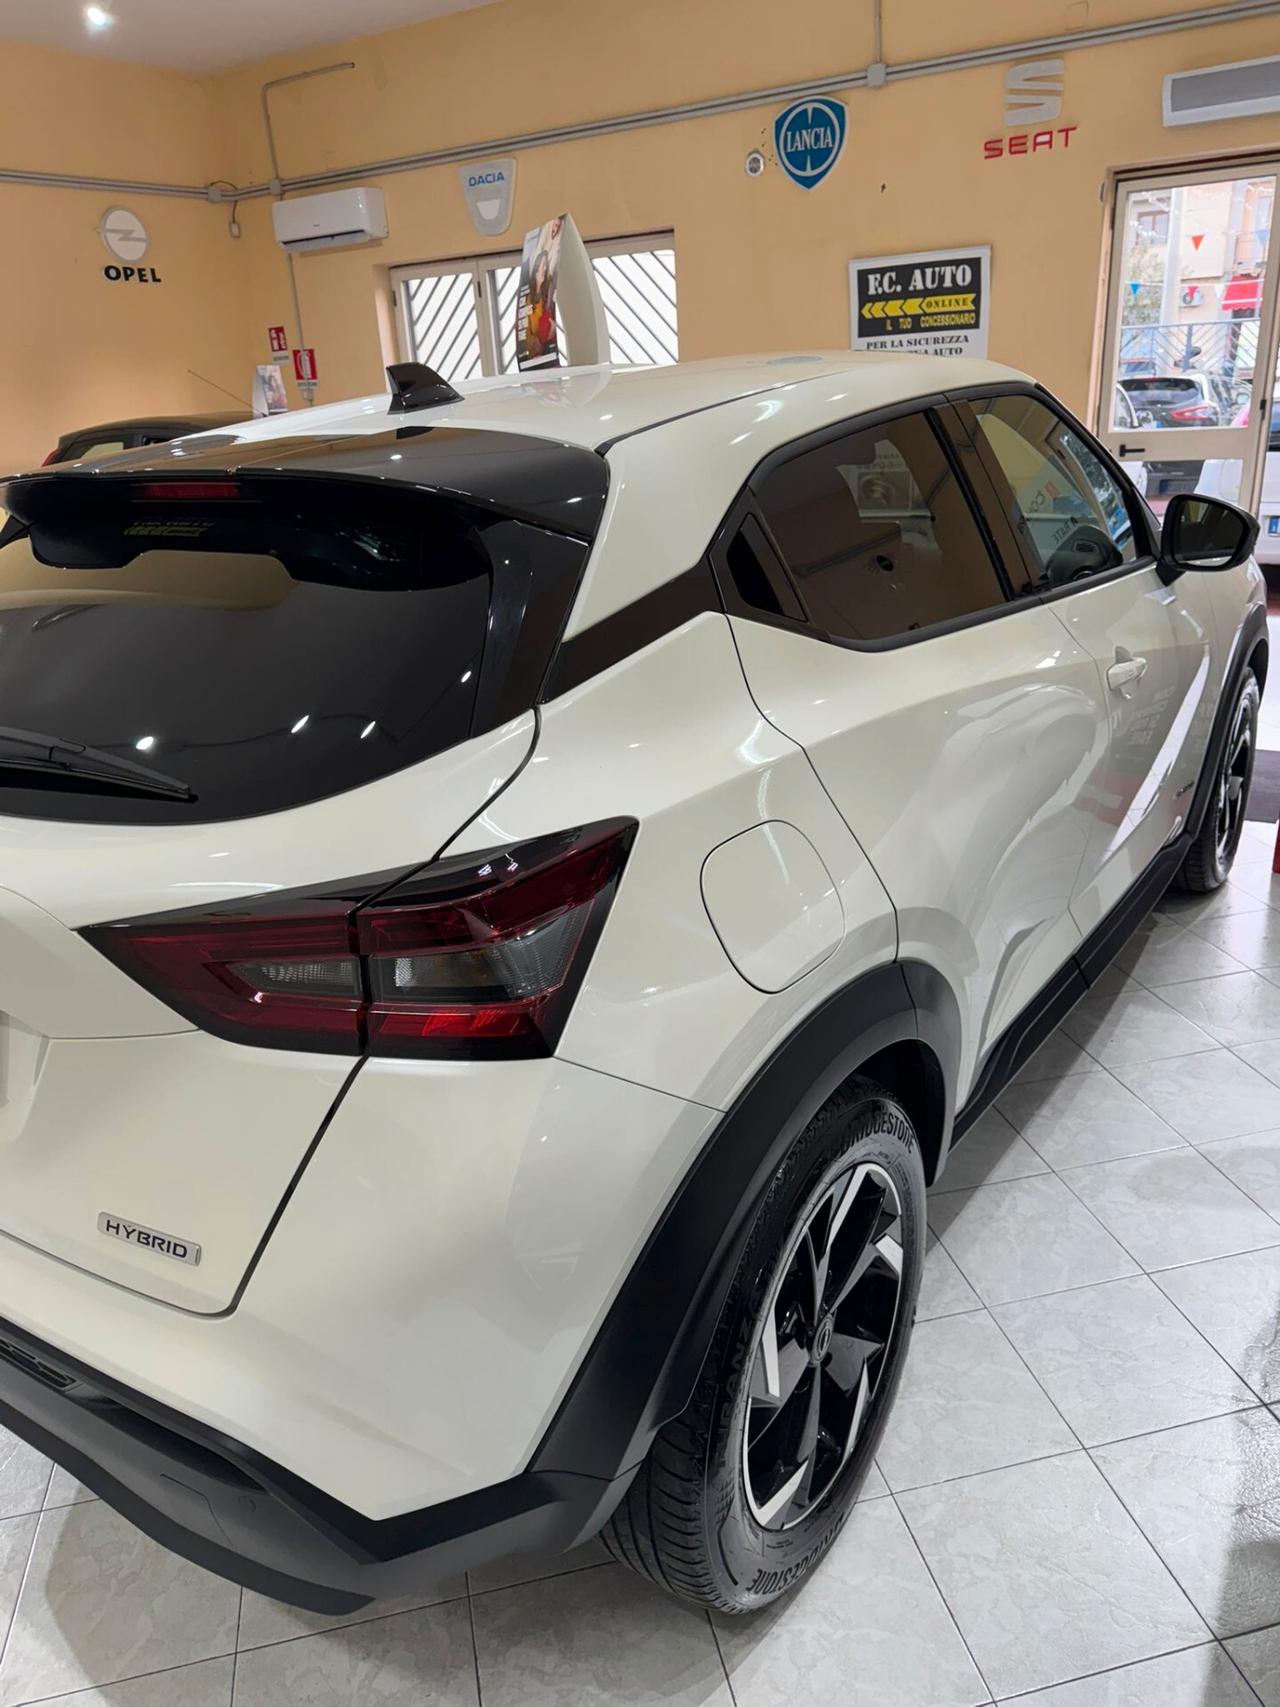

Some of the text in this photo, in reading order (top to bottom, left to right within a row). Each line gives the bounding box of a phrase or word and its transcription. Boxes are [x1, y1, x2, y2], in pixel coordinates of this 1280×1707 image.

[785, 126, 834, 153] LANCIA
[983, 126, 1078, 160] SEAT
[468, 172, 505, 187] DACIA
[104, 265, 162, 283] OPEL
[908, 264, 972, 291] AUTO
[926, 297, 970, 309] ONLINE
[885, 312, 976, 331] IL TUO CONCESSIONARIO
[866, 335, 969, 350] PER LA SICUREZZA
[930, 347, 963, 356] AUTO
[105, 1219, 188, 1259] HYBRID
